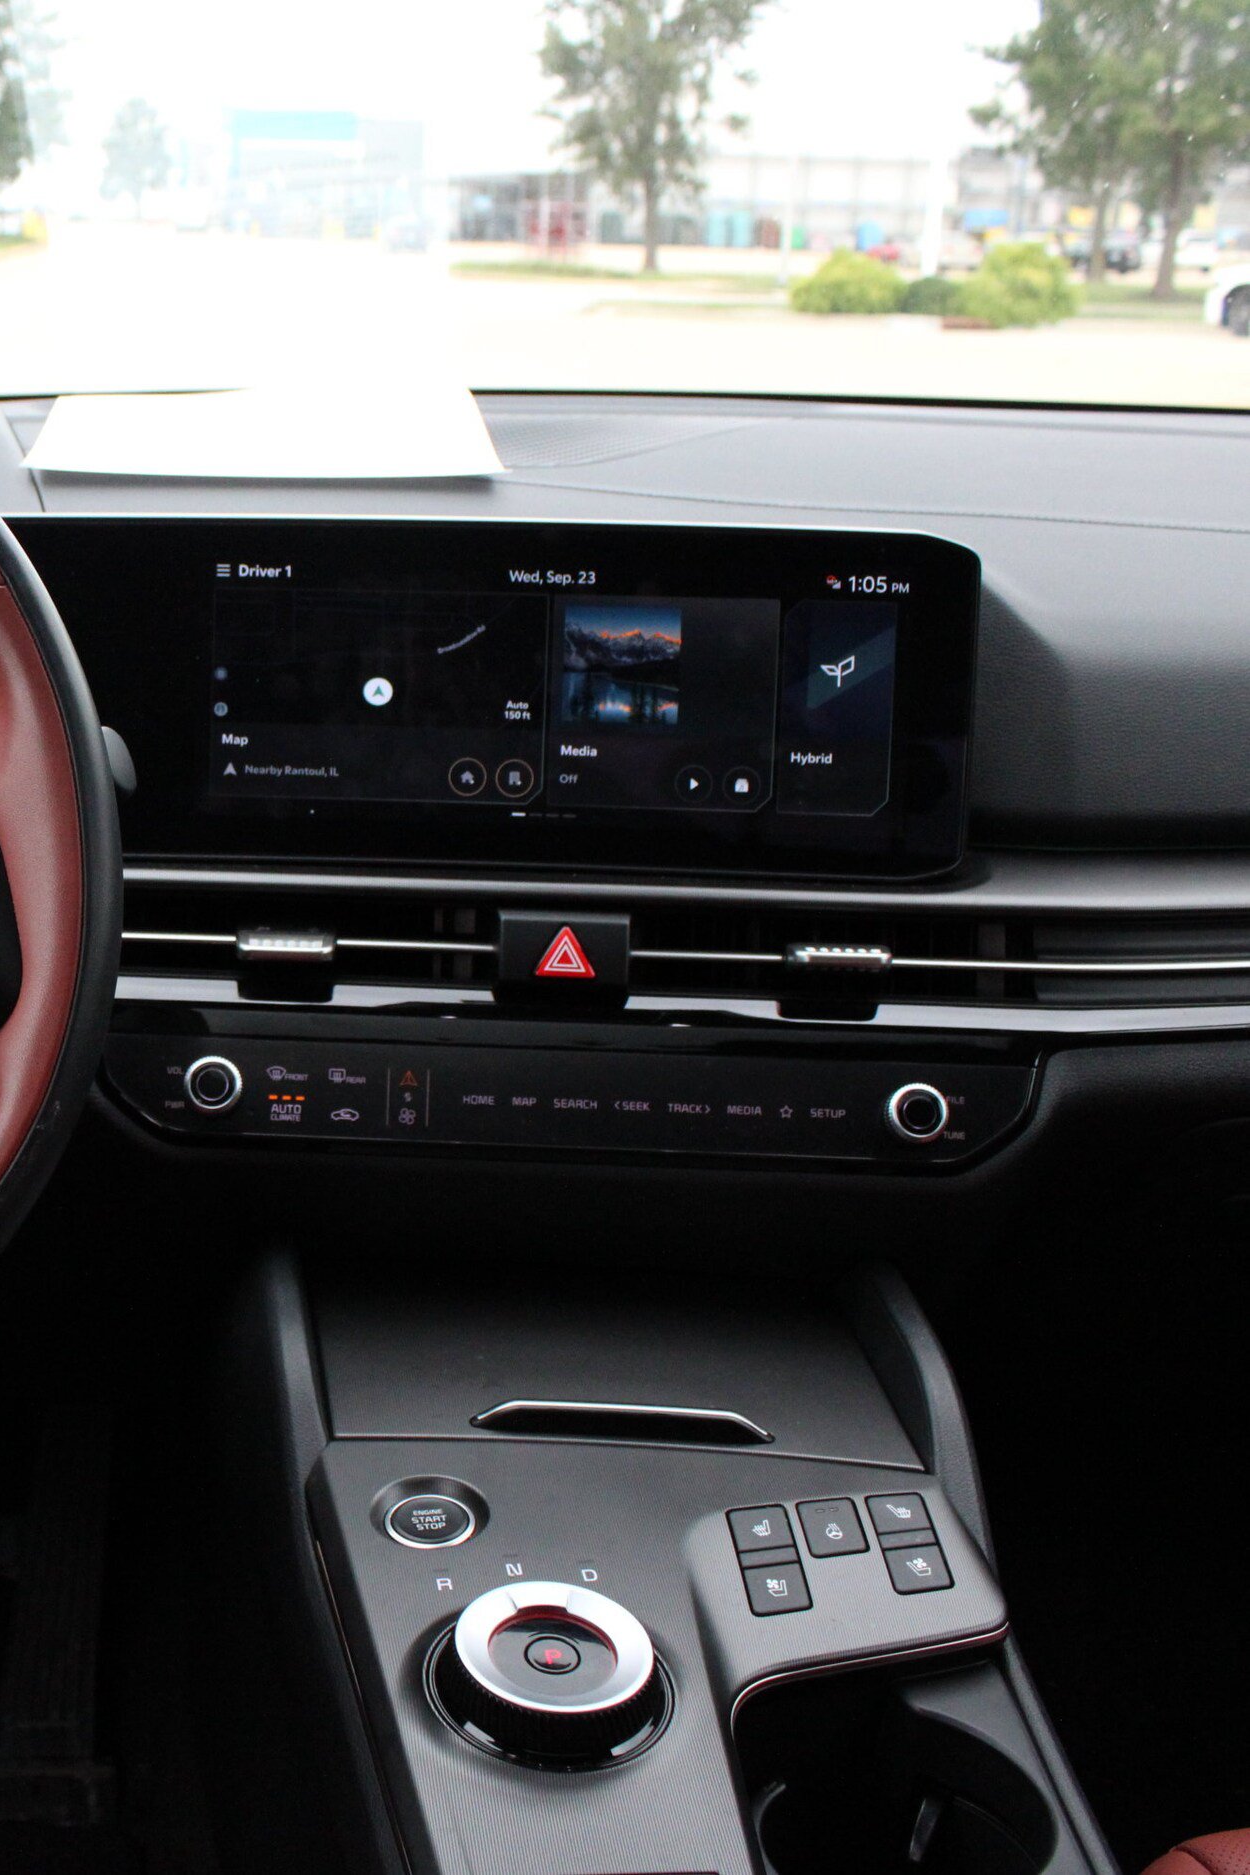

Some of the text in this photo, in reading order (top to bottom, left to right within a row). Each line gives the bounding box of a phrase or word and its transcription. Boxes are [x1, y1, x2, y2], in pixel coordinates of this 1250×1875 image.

[238, 563, 292, 579] Driver 1
[509, 569, 597, 586] Wed, Sep. 23
[847, 575, 910, 594] 1:05 PM
[505, 700, 529, 710] Auto
[504, 710, 531, 720] 150 ft
[221, 733, 249, 747] Map
[560, 745, 598, 757] Media
[790, 752, 833, 766] Hybrid
[244, 764, 282, 778] Nearby
[284, 765, 327, 778] Rantoul,
[559, 773, 578, 784] Off
[166, 1066, 183, 1075] VOL
[284, 1073, 309, 1082] FRONT
[346, 1076, 366, 1084] REAR
[462, 1094, 496, 1106] HOME
[512, 1096, 537, 1107] MAP
[553, 1098, 598, 1109] SEARCH
[270, 1104, 302, 1114] AUTO
[727, 1104, 762, 1115] MEDIA
[810, 1107, 846, 1119] SETUP
[270, 1113, 302, 1122] CLIMATE
[411, 1515, 447, 1523] START
[416, 1522, 446, 1530] STOP
[505, 1563, 523, 1576] N
[582, 1569, 598, 1582] D
[436, 1578, 453, 1591] R
[544, 1649, 562, 1664] P
